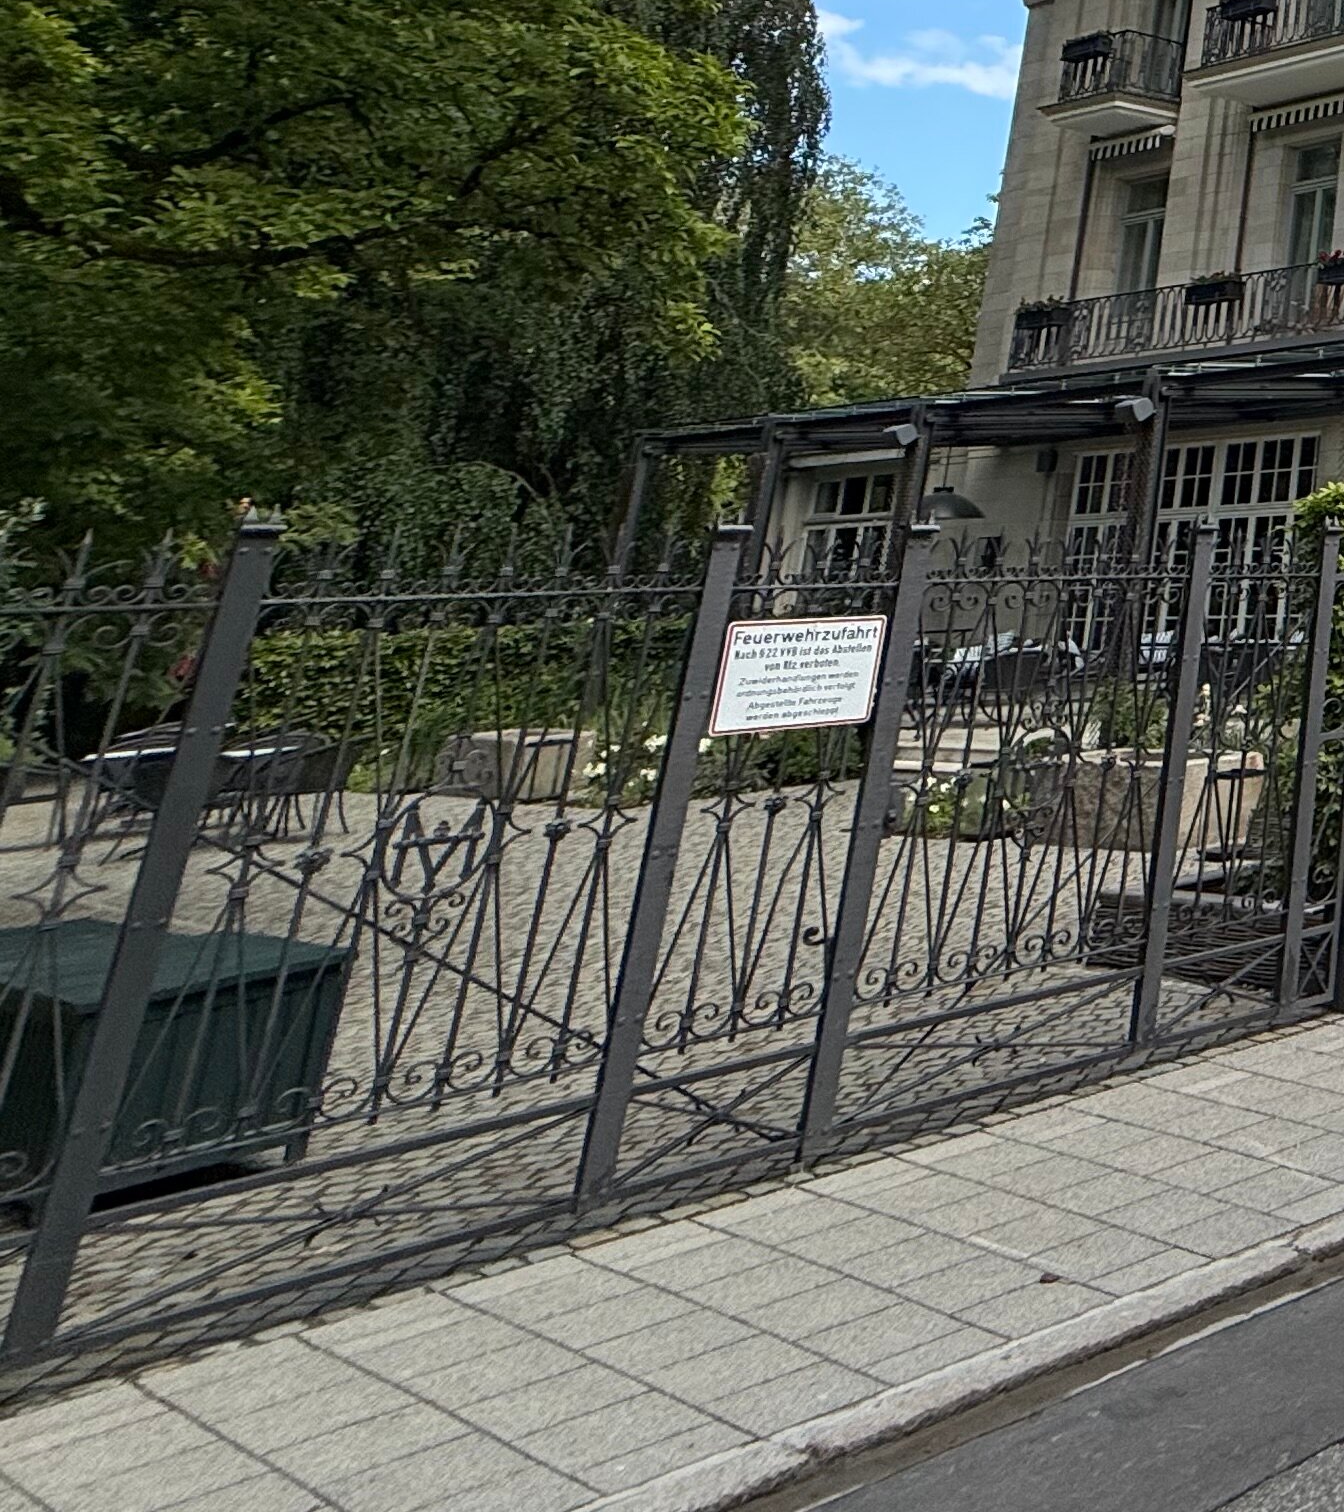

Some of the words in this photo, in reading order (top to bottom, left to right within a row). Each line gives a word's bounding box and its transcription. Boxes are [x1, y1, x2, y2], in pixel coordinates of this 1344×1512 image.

[733, 626, 878, 646] Feuerwehrzufahrt
[735, 649, 757, 661] Nach
[799, 646, 812, 656] ist
[813, 645, 829, 655] das
[832, 643, 872, 654] Abstellen
[765, 662, 780, 671] von
[738, 673, 826, 686] Zuwiderhandlungen
[828, 671, 859, 680] werden
[798, 696, 842, 706] Fahrzeuge
[746, 712, 779, 721] werden
